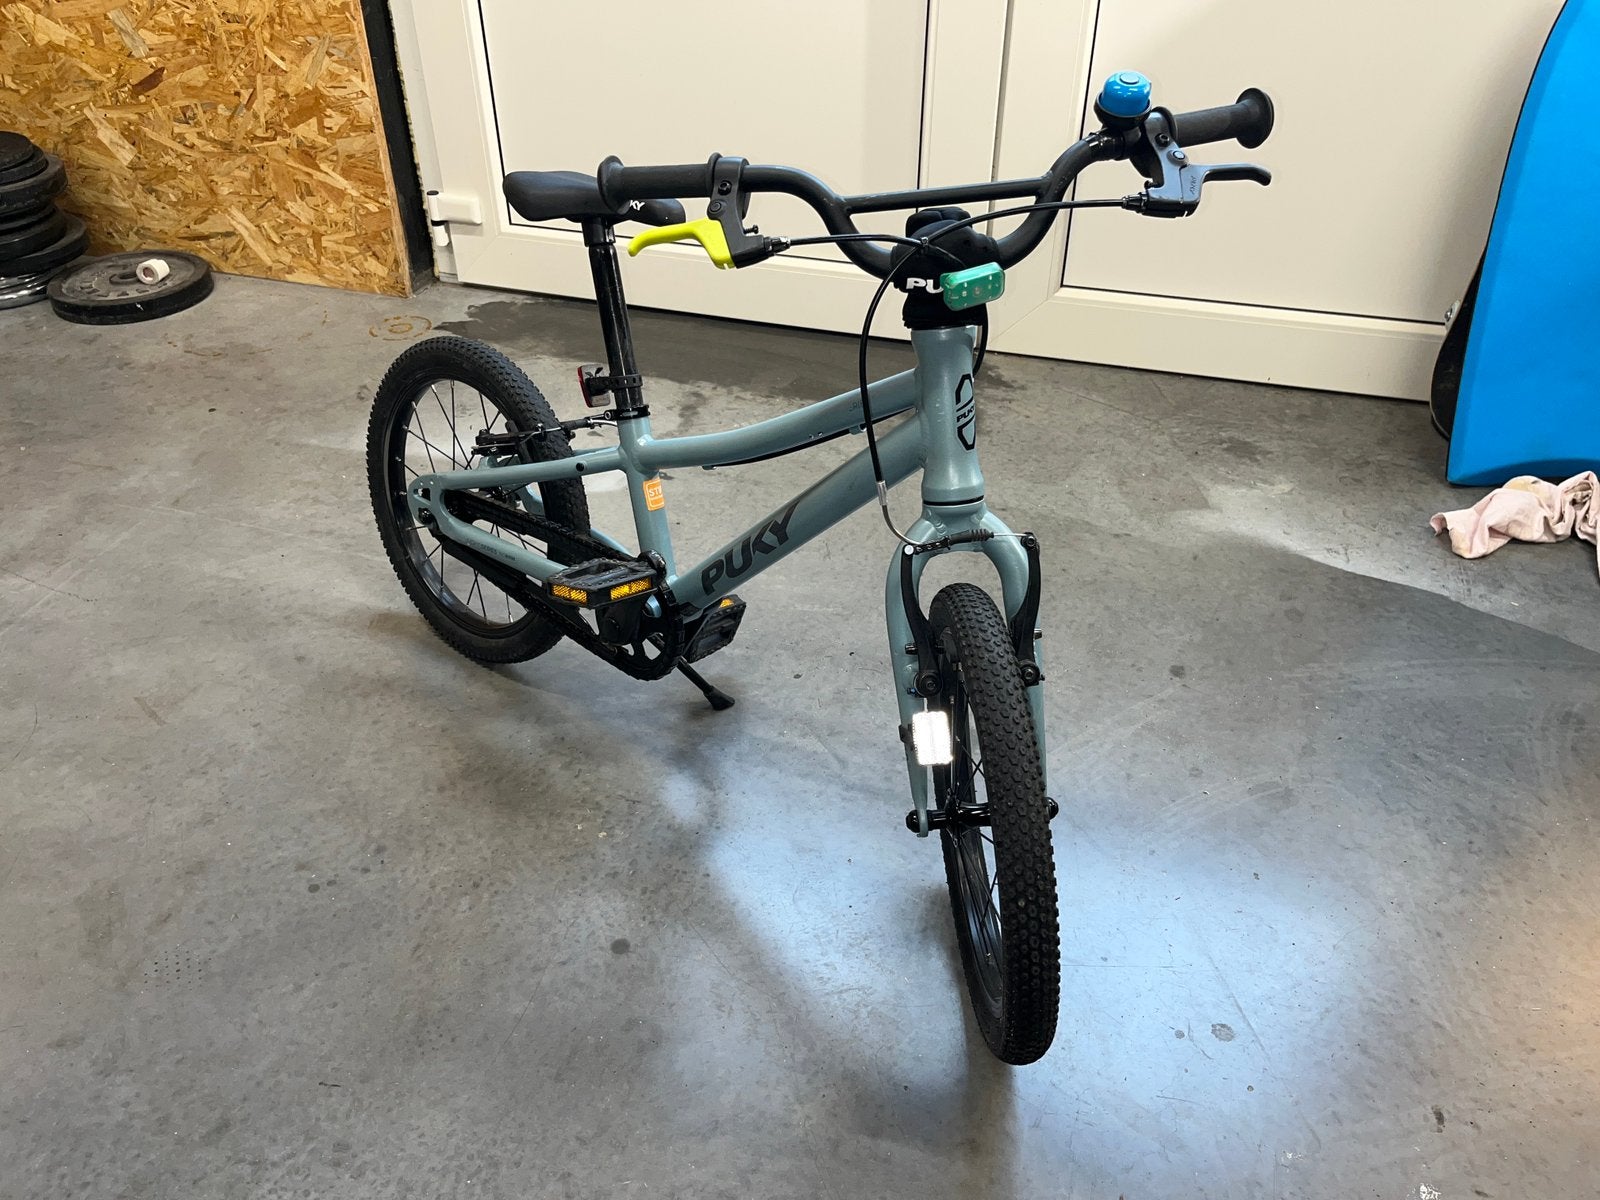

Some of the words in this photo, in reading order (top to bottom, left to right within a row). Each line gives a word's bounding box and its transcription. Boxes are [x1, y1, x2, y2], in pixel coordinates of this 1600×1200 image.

[629, 199, 646, 211] KY
[906, 277, 944, 294] PU
[956, 405, 976, 423] PUK
[701, 500, 800, 596] PUKY
